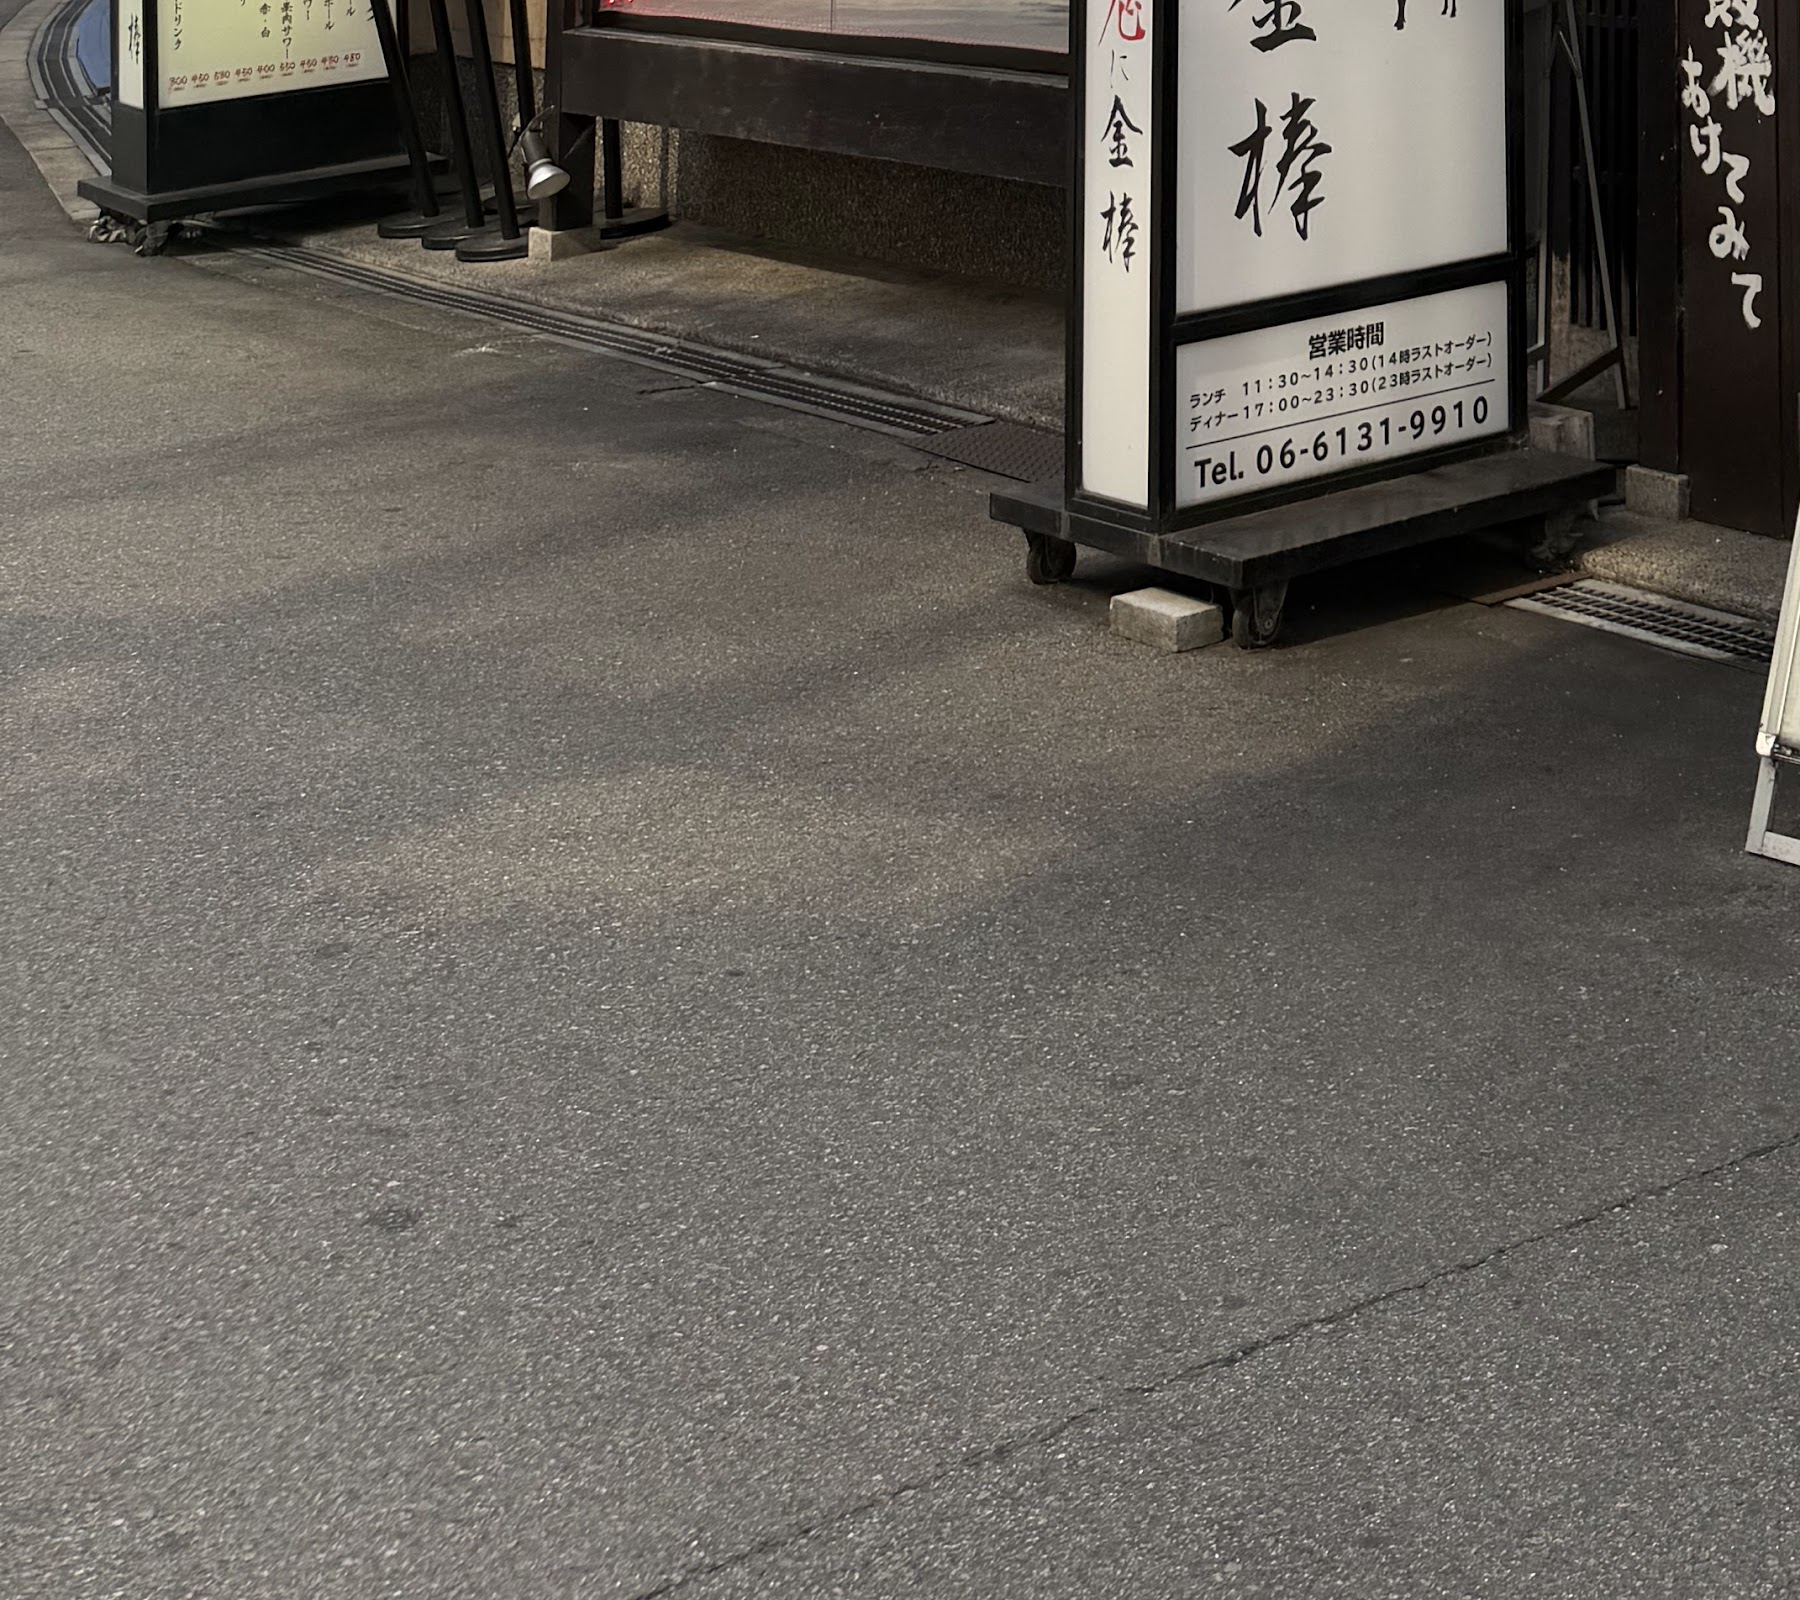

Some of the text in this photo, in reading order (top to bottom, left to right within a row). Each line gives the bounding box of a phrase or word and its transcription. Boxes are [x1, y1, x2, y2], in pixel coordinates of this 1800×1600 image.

[1308, 321, 1384, 360] 営業時間
[1189, 388, 1226, 409] ランチ
[1194, 395, 1490, 489] Tel. 06-6131-9910
